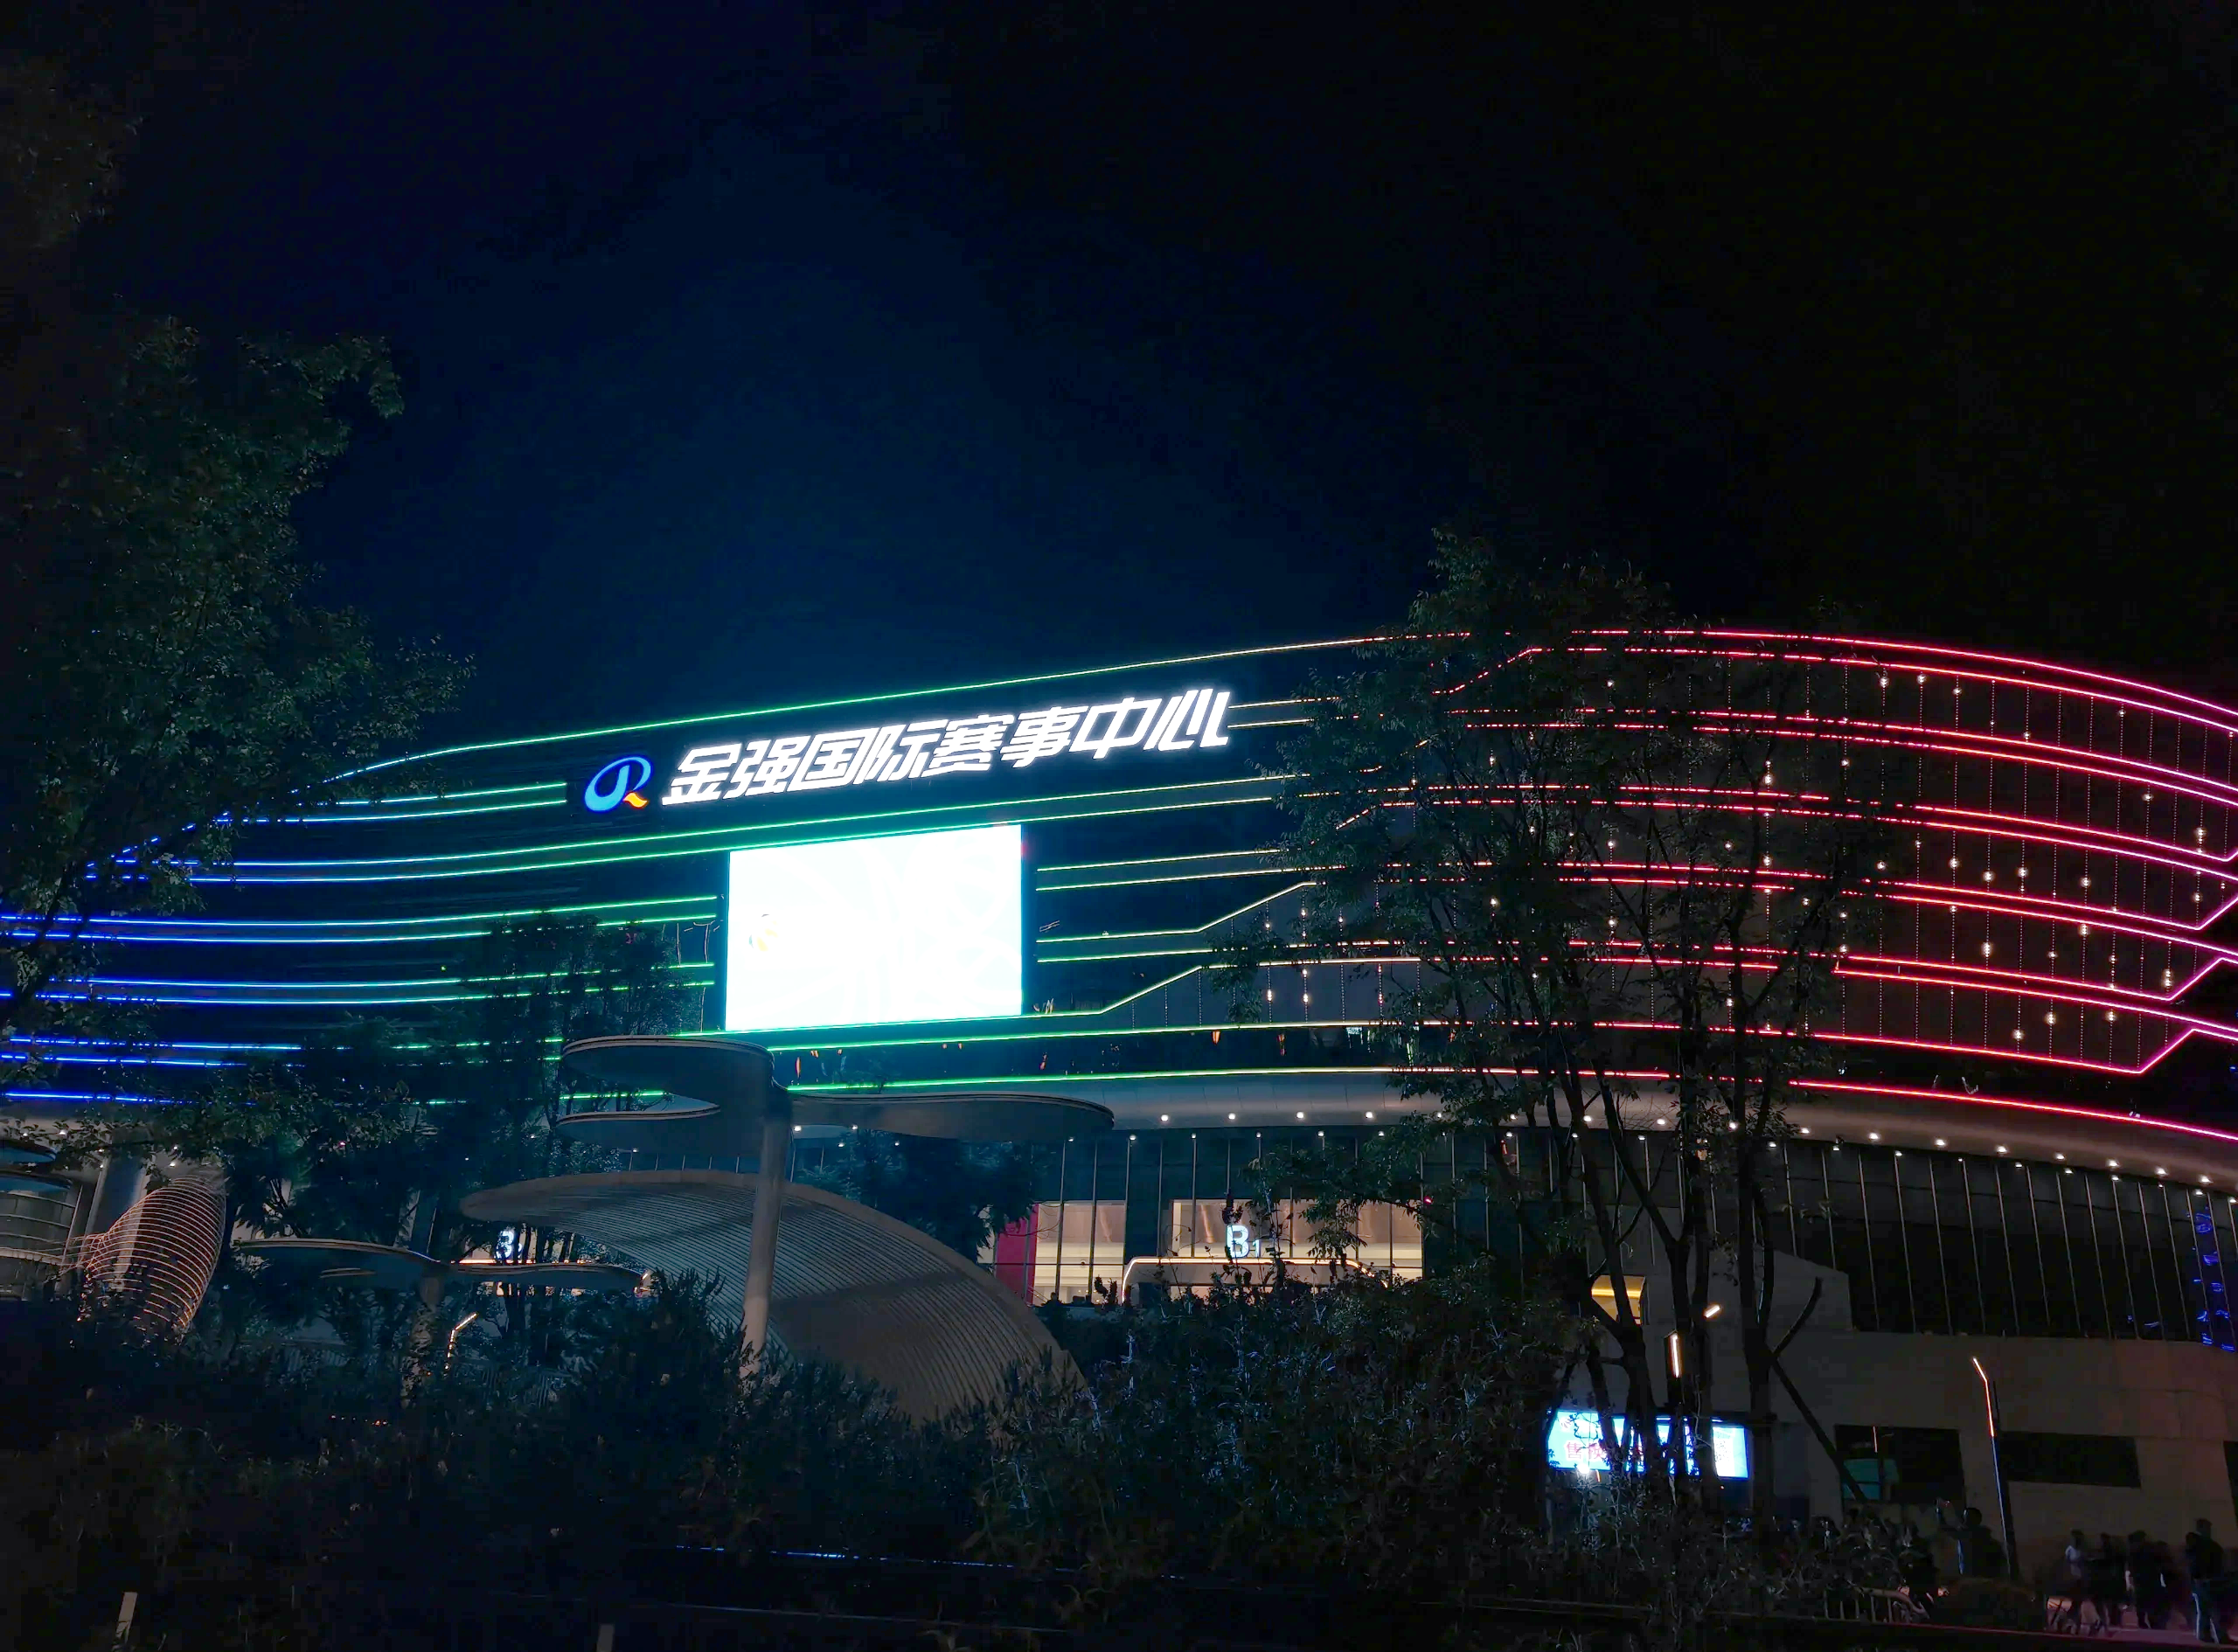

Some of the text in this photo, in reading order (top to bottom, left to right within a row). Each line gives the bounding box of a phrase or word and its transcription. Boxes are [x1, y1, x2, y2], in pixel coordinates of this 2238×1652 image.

[662, 688, 1230, 805] 金强国际赛事中心
[1227, 1225, 1260, 1259] B1
